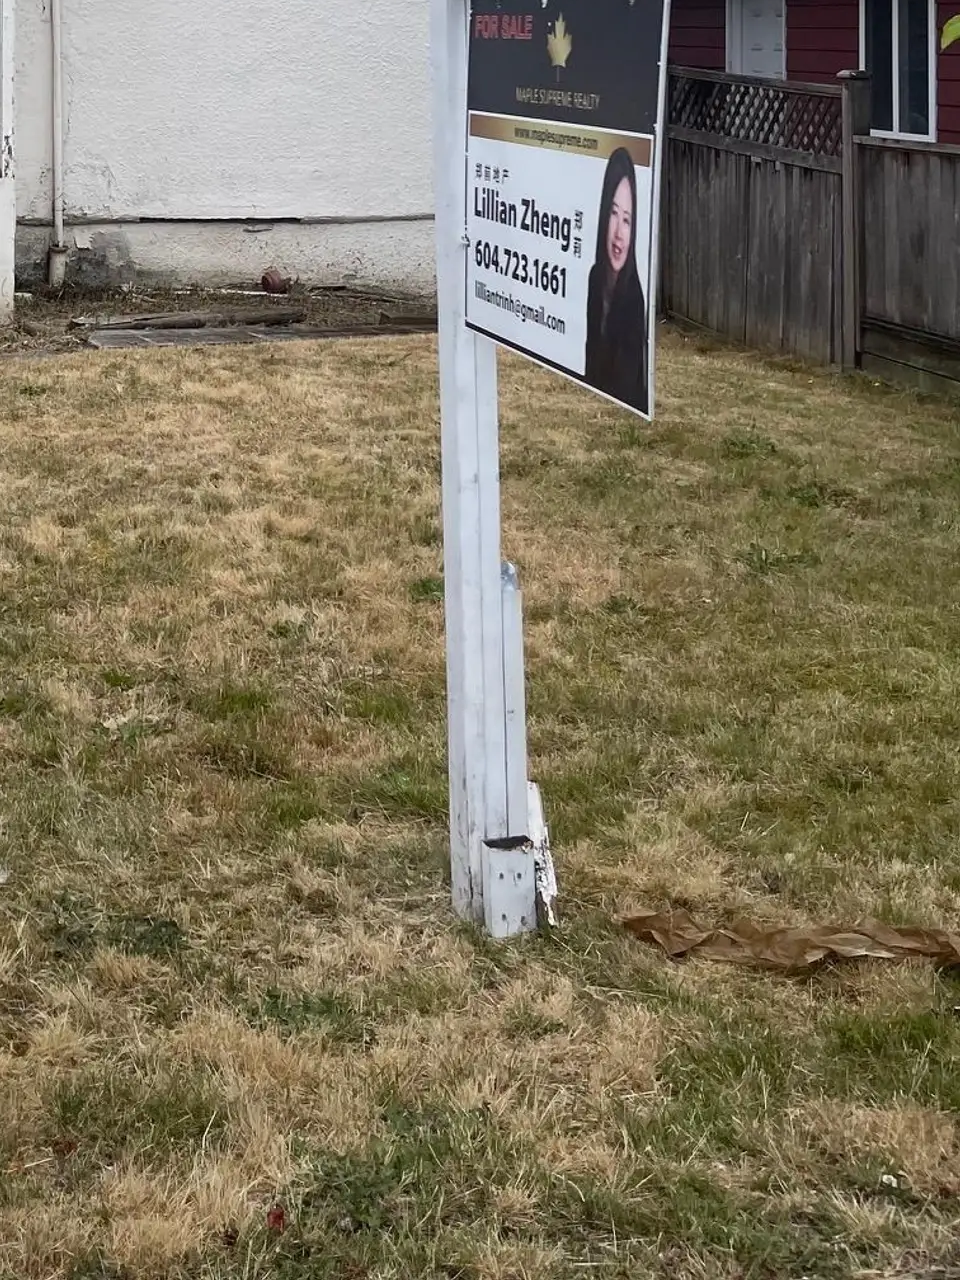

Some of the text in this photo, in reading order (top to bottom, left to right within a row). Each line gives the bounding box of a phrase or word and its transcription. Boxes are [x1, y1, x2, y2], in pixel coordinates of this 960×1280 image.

[474, 14, 533, 40] FOR SALE
[515, 86, 600, 110] MAPLE SUPREME REALTY
[474, 186, 572, 252] Lillian Zheng
[474, 239, 567, 298] 604.723.1661
